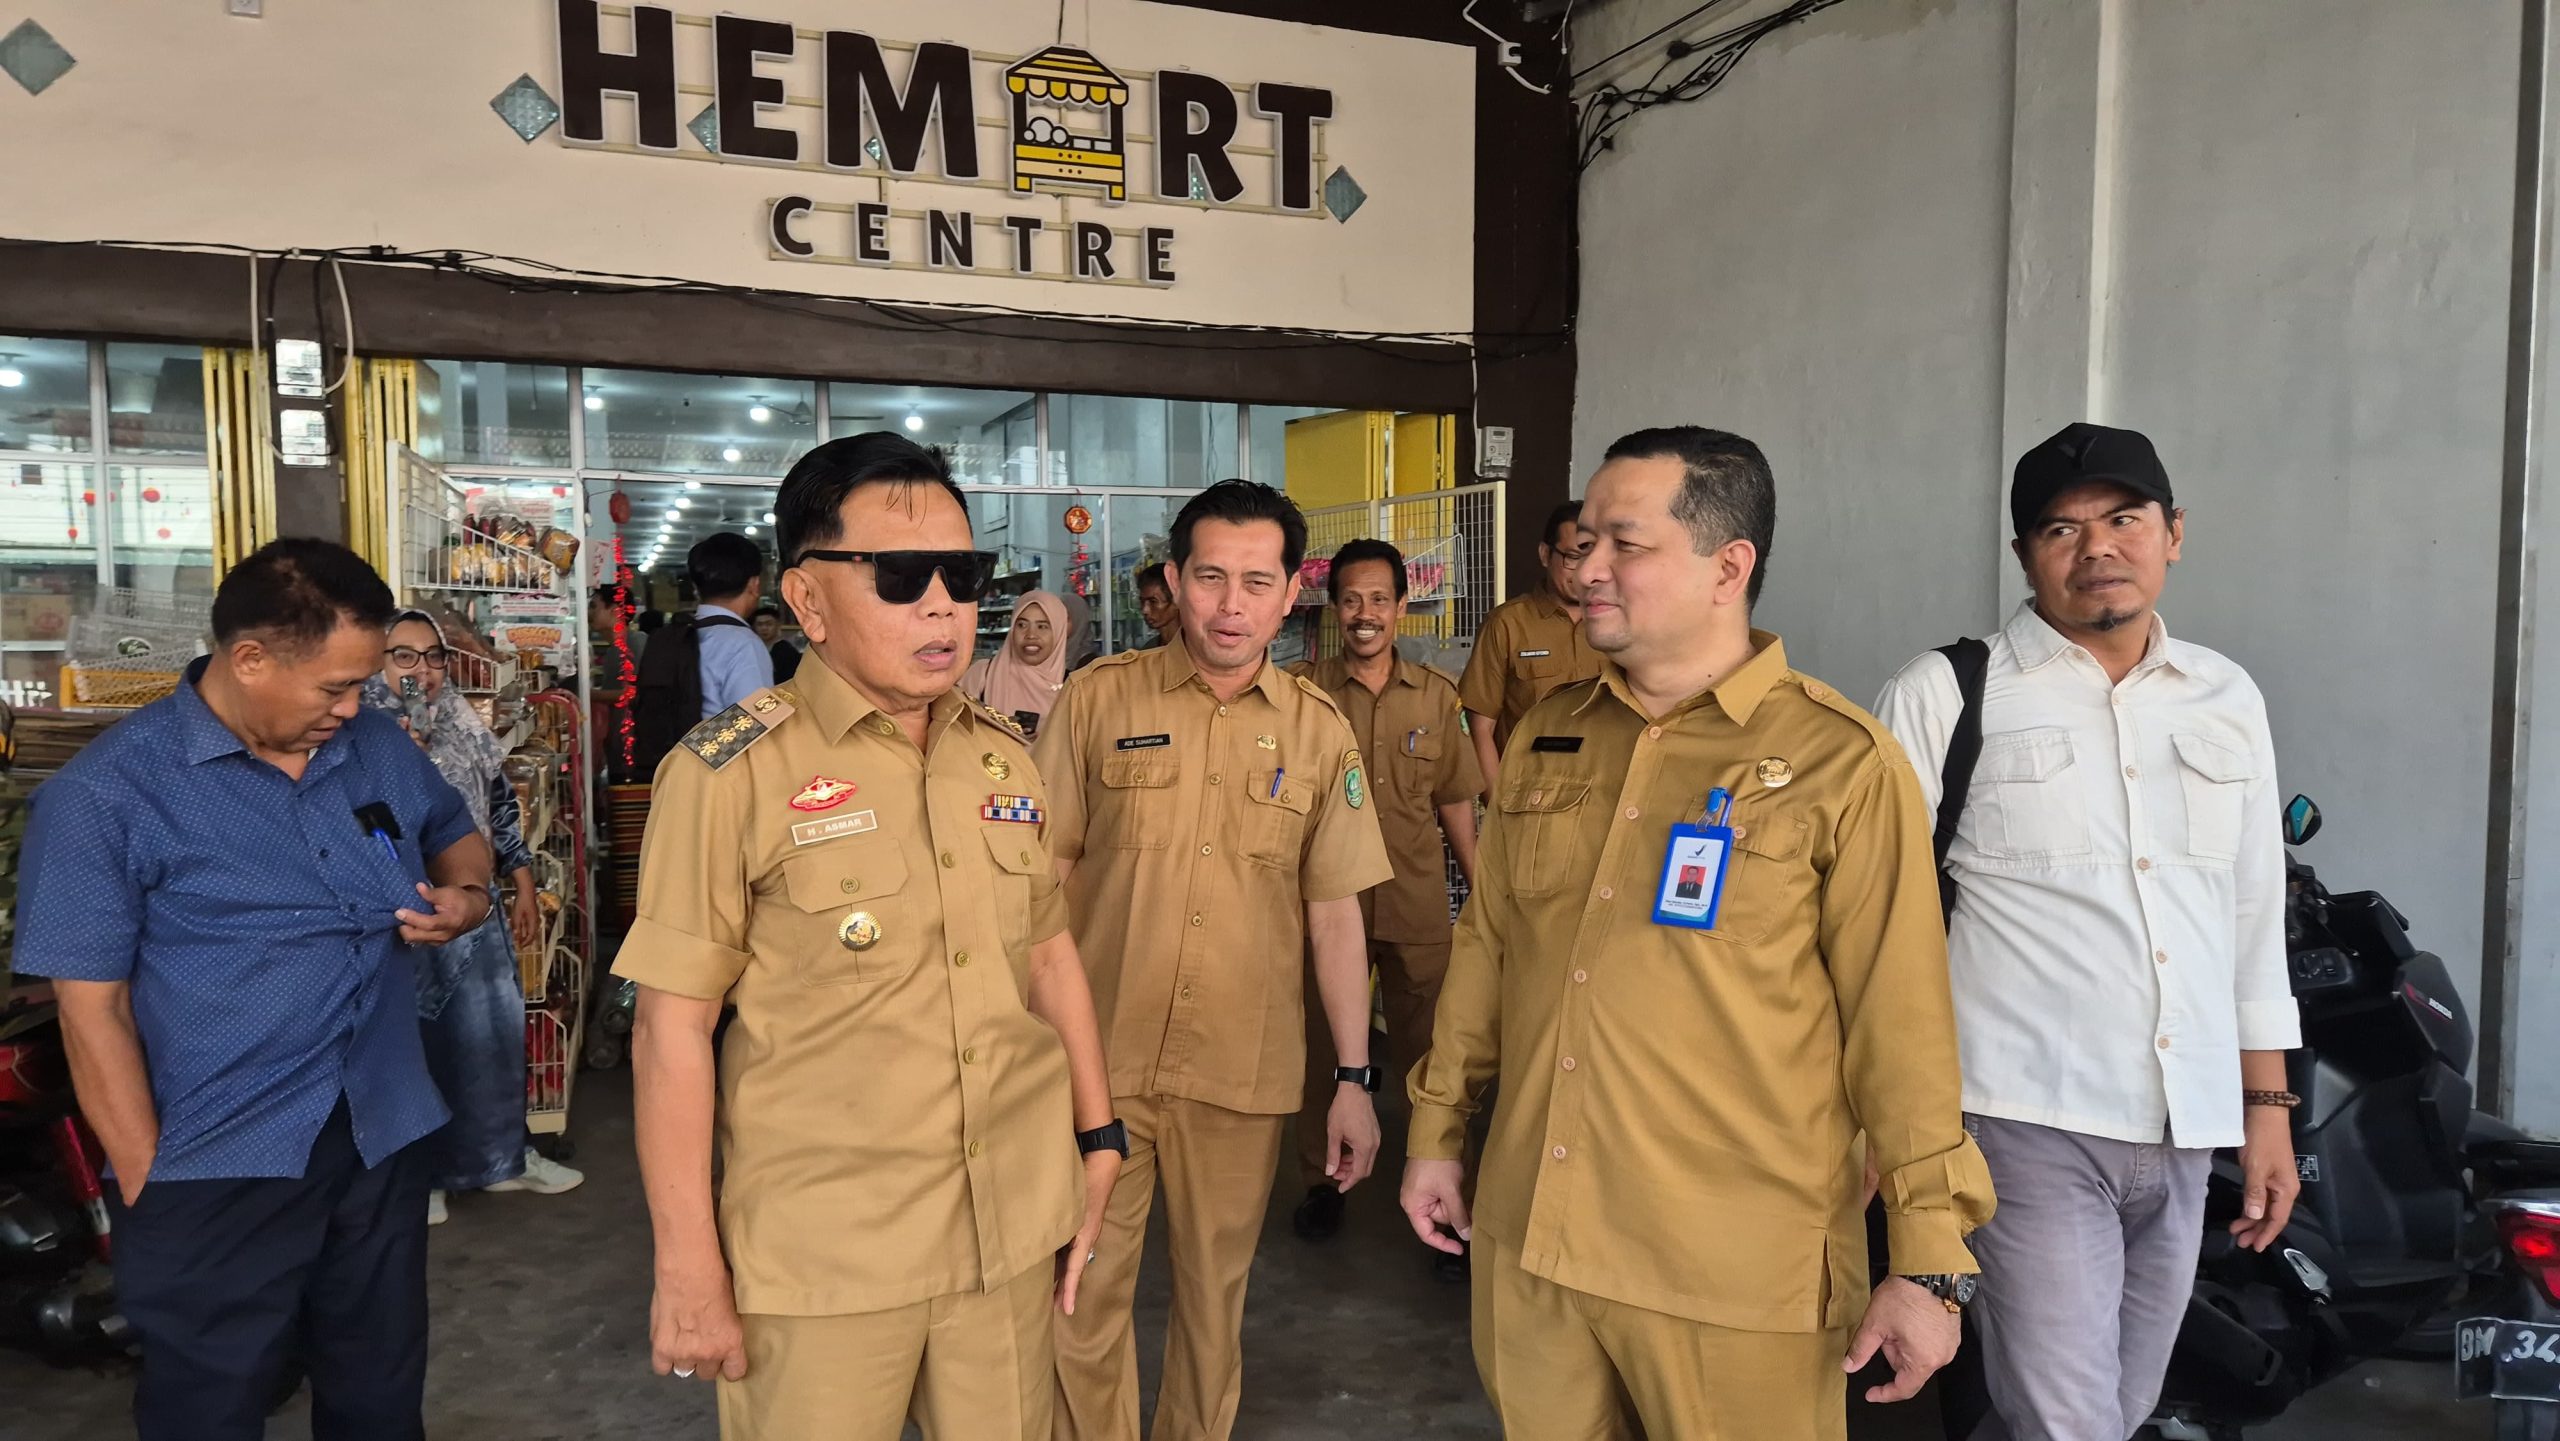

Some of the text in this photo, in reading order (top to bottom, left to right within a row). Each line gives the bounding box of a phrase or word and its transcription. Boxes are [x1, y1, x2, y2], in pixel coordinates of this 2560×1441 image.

[771, 195, 1178, 283] CENTRE
[824, 817, 862, 833] ASMAR
[2461, 1326, 2497, 1362] BM
